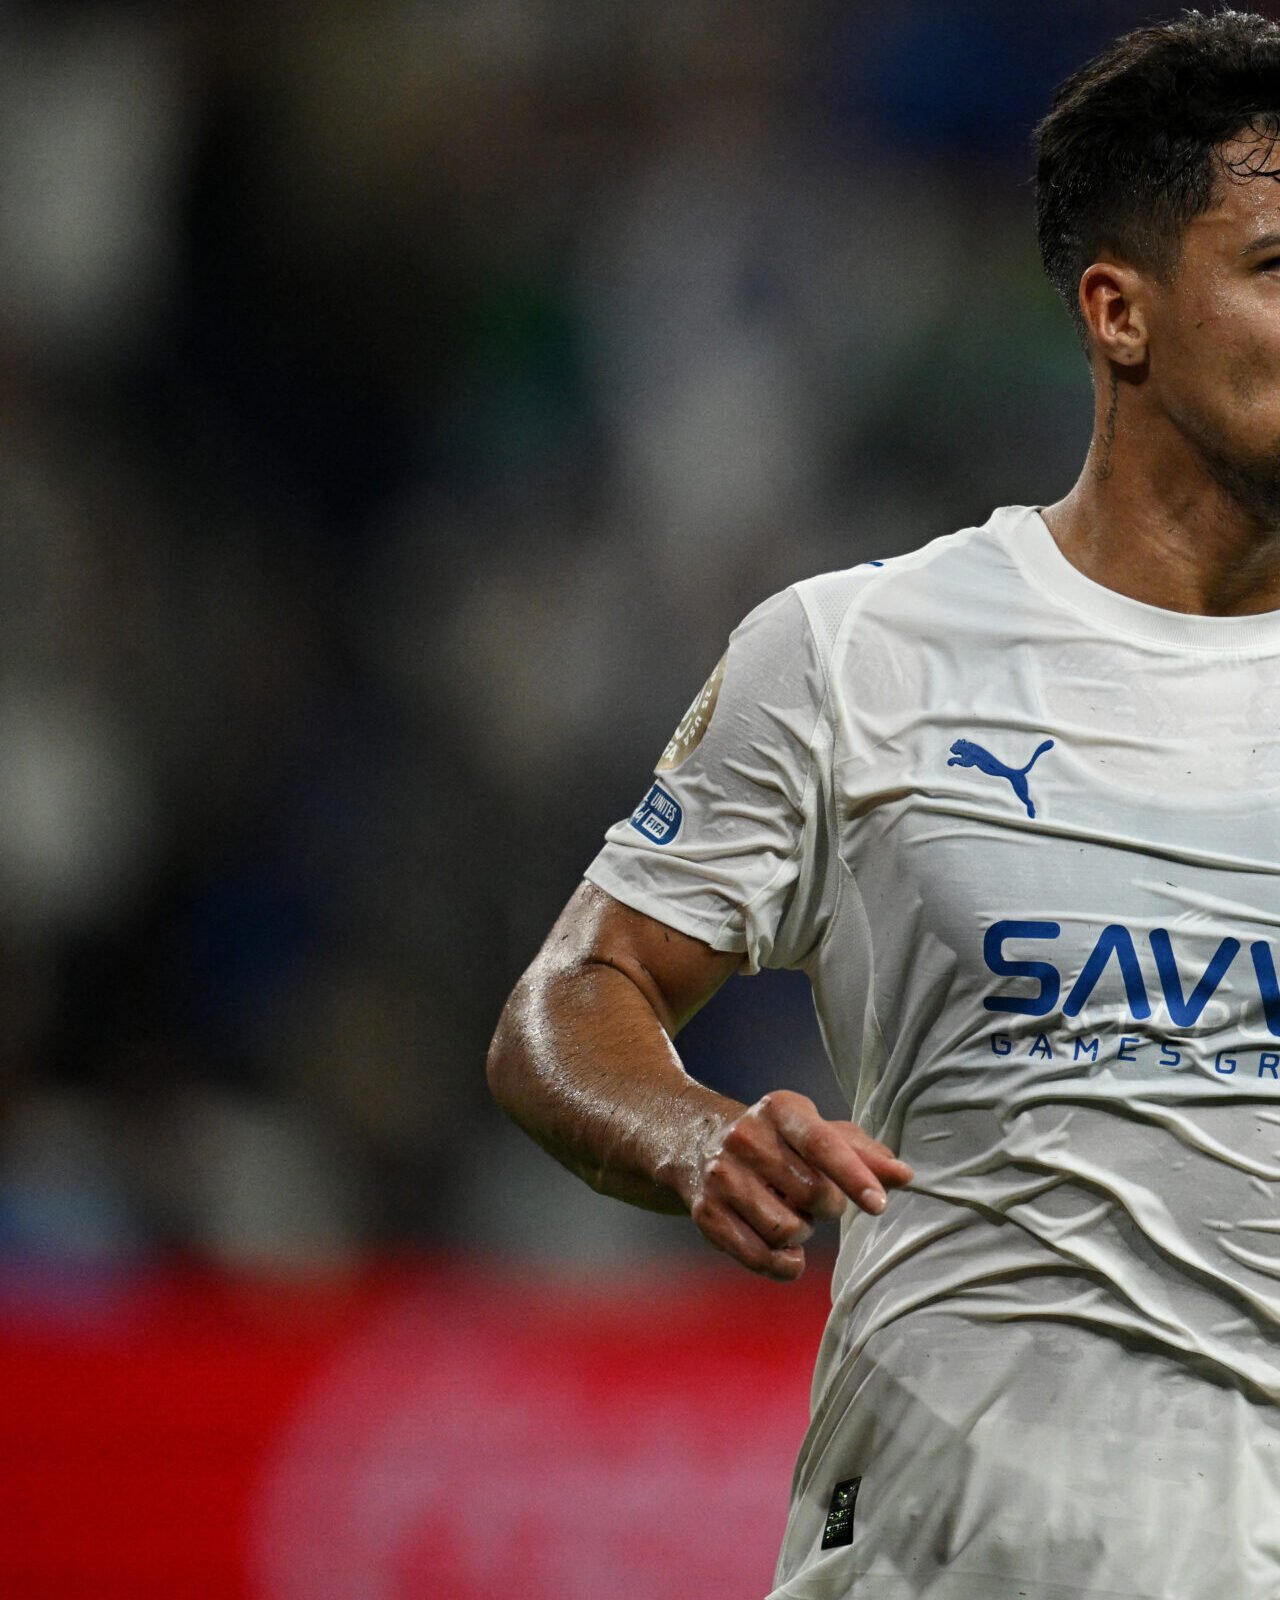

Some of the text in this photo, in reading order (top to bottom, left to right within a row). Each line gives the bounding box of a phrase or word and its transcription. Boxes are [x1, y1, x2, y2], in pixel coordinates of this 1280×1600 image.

[650, 792, 677, 822] UNITES
[646, 817, 665, 837] FIFA
[990, 1033, 1182, 1067] GAMES
